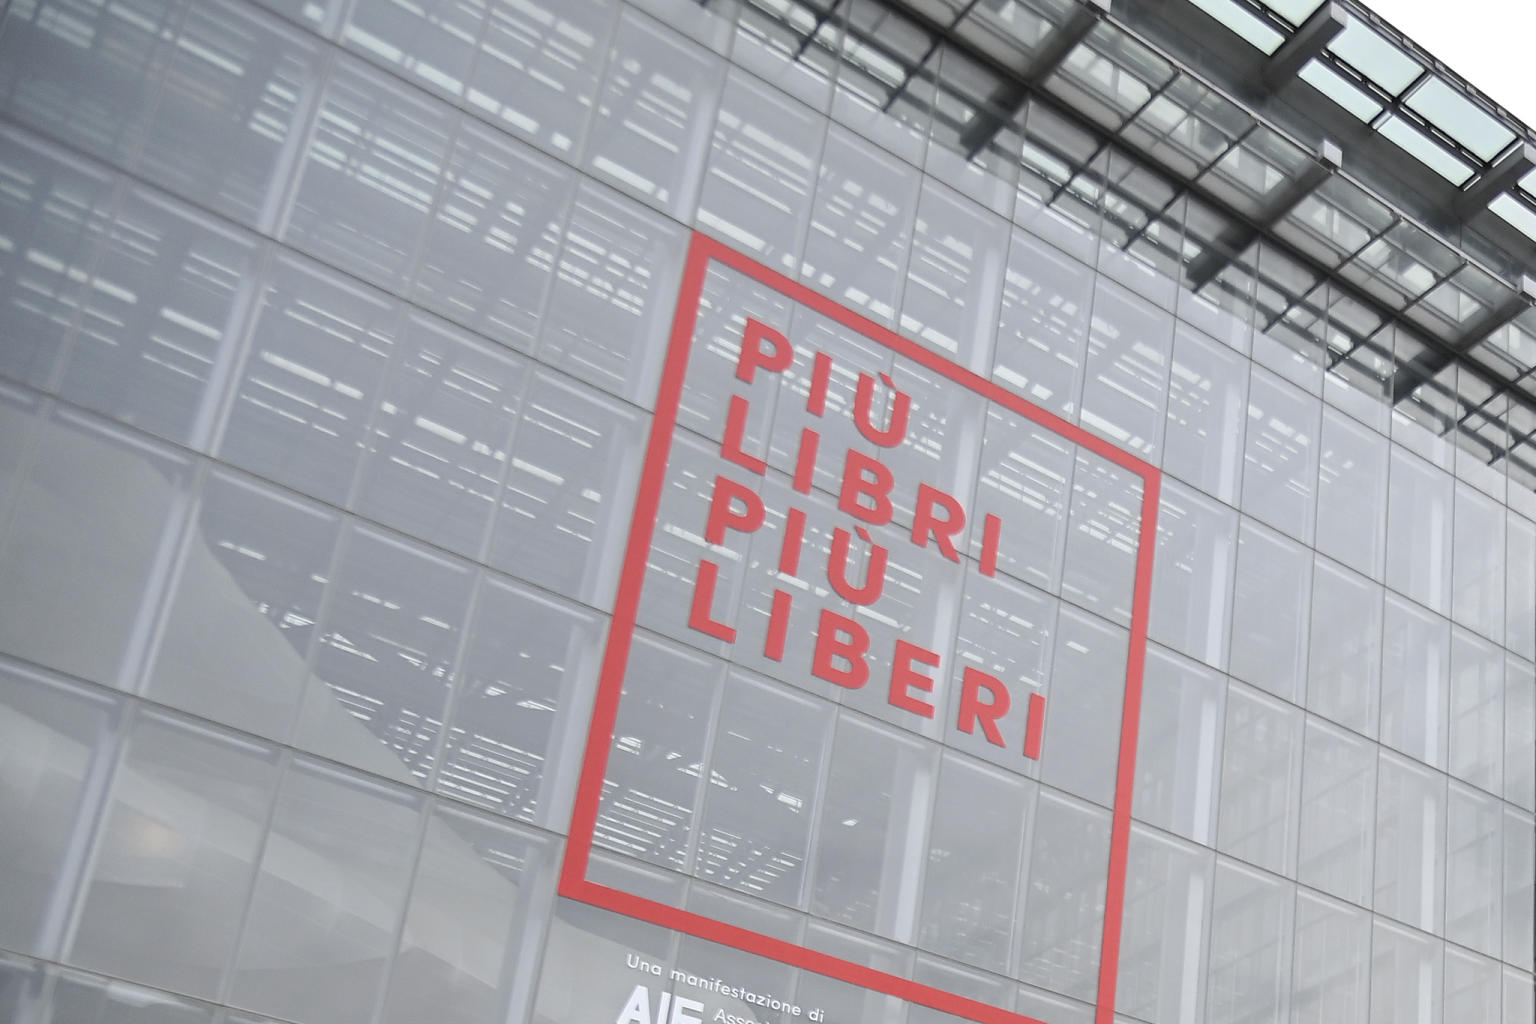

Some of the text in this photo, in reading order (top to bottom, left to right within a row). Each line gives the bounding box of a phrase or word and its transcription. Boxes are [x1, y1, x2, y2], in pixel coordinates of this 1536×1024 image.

[736, 317, 911, 448] PIÙ
[704, 474, 889, 606] PIÙ
[720, 393, 1001, 578] LIBRI
[687, 558, 1046, 761] LIBERI
[626, 953, 825, 1024] Una manifestazione di
